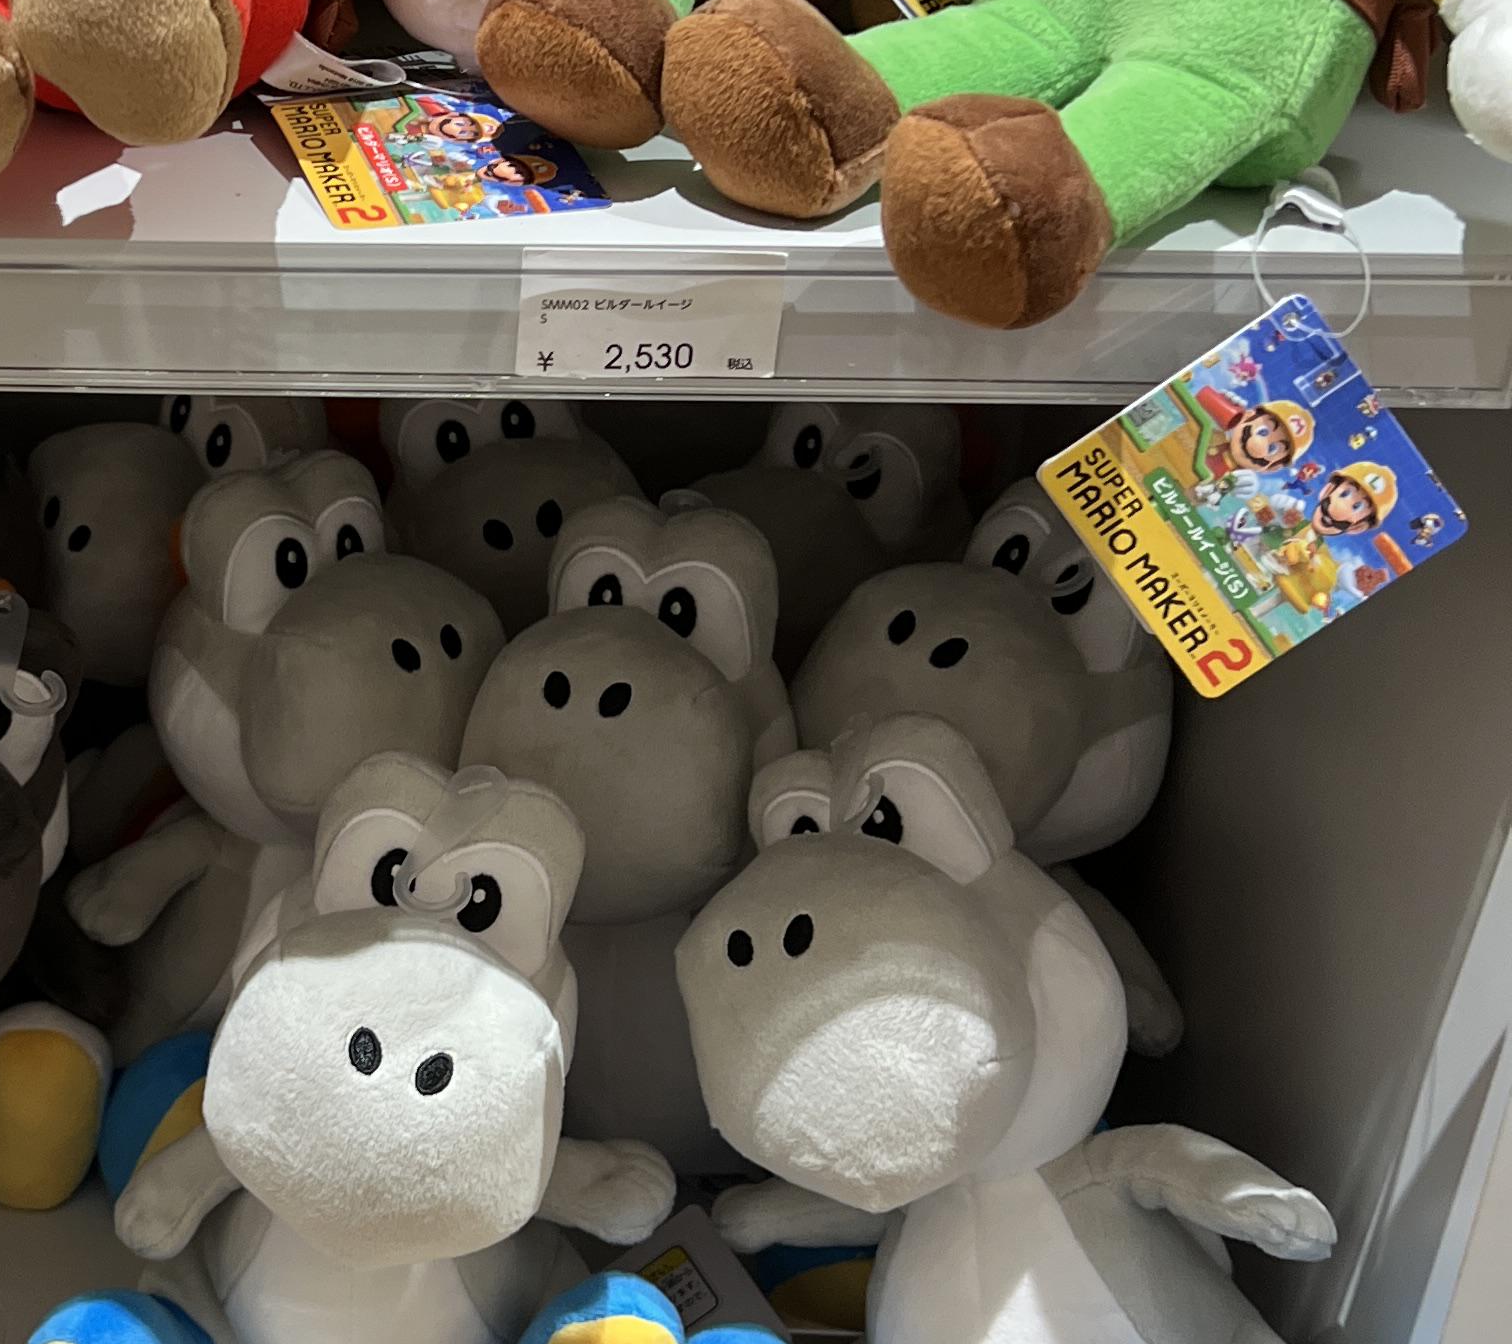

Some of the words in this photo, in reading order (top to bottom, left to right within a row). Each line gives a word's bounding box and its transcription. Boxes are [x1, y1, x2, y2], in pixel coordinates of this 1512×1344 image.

[307, 103, 342, 135] SUPER
[280, 106, 328, 148] MARIO
[305, 151, 356, 203] MAKER
[335, 205, 389, 224] 2
[540, 314, 548, 324] S
[541, 299, 589, 310] SMM02
[594, 298, 694, 310] ビルダールイージ
[537, 351, 554, 372] ¥
[604, 343, 694, 373] 2,530
[728, 358, 753, 370] 税込
[1082, 443, 1144, 520] SUPER
[1151, 472, 1249, 603] ビルダールイージ(S)
[1054, 457, 1140, 560] MARIO
[1124, 548, 1210, 656] MAKER
[1195, 626, 1256, 694] 2
